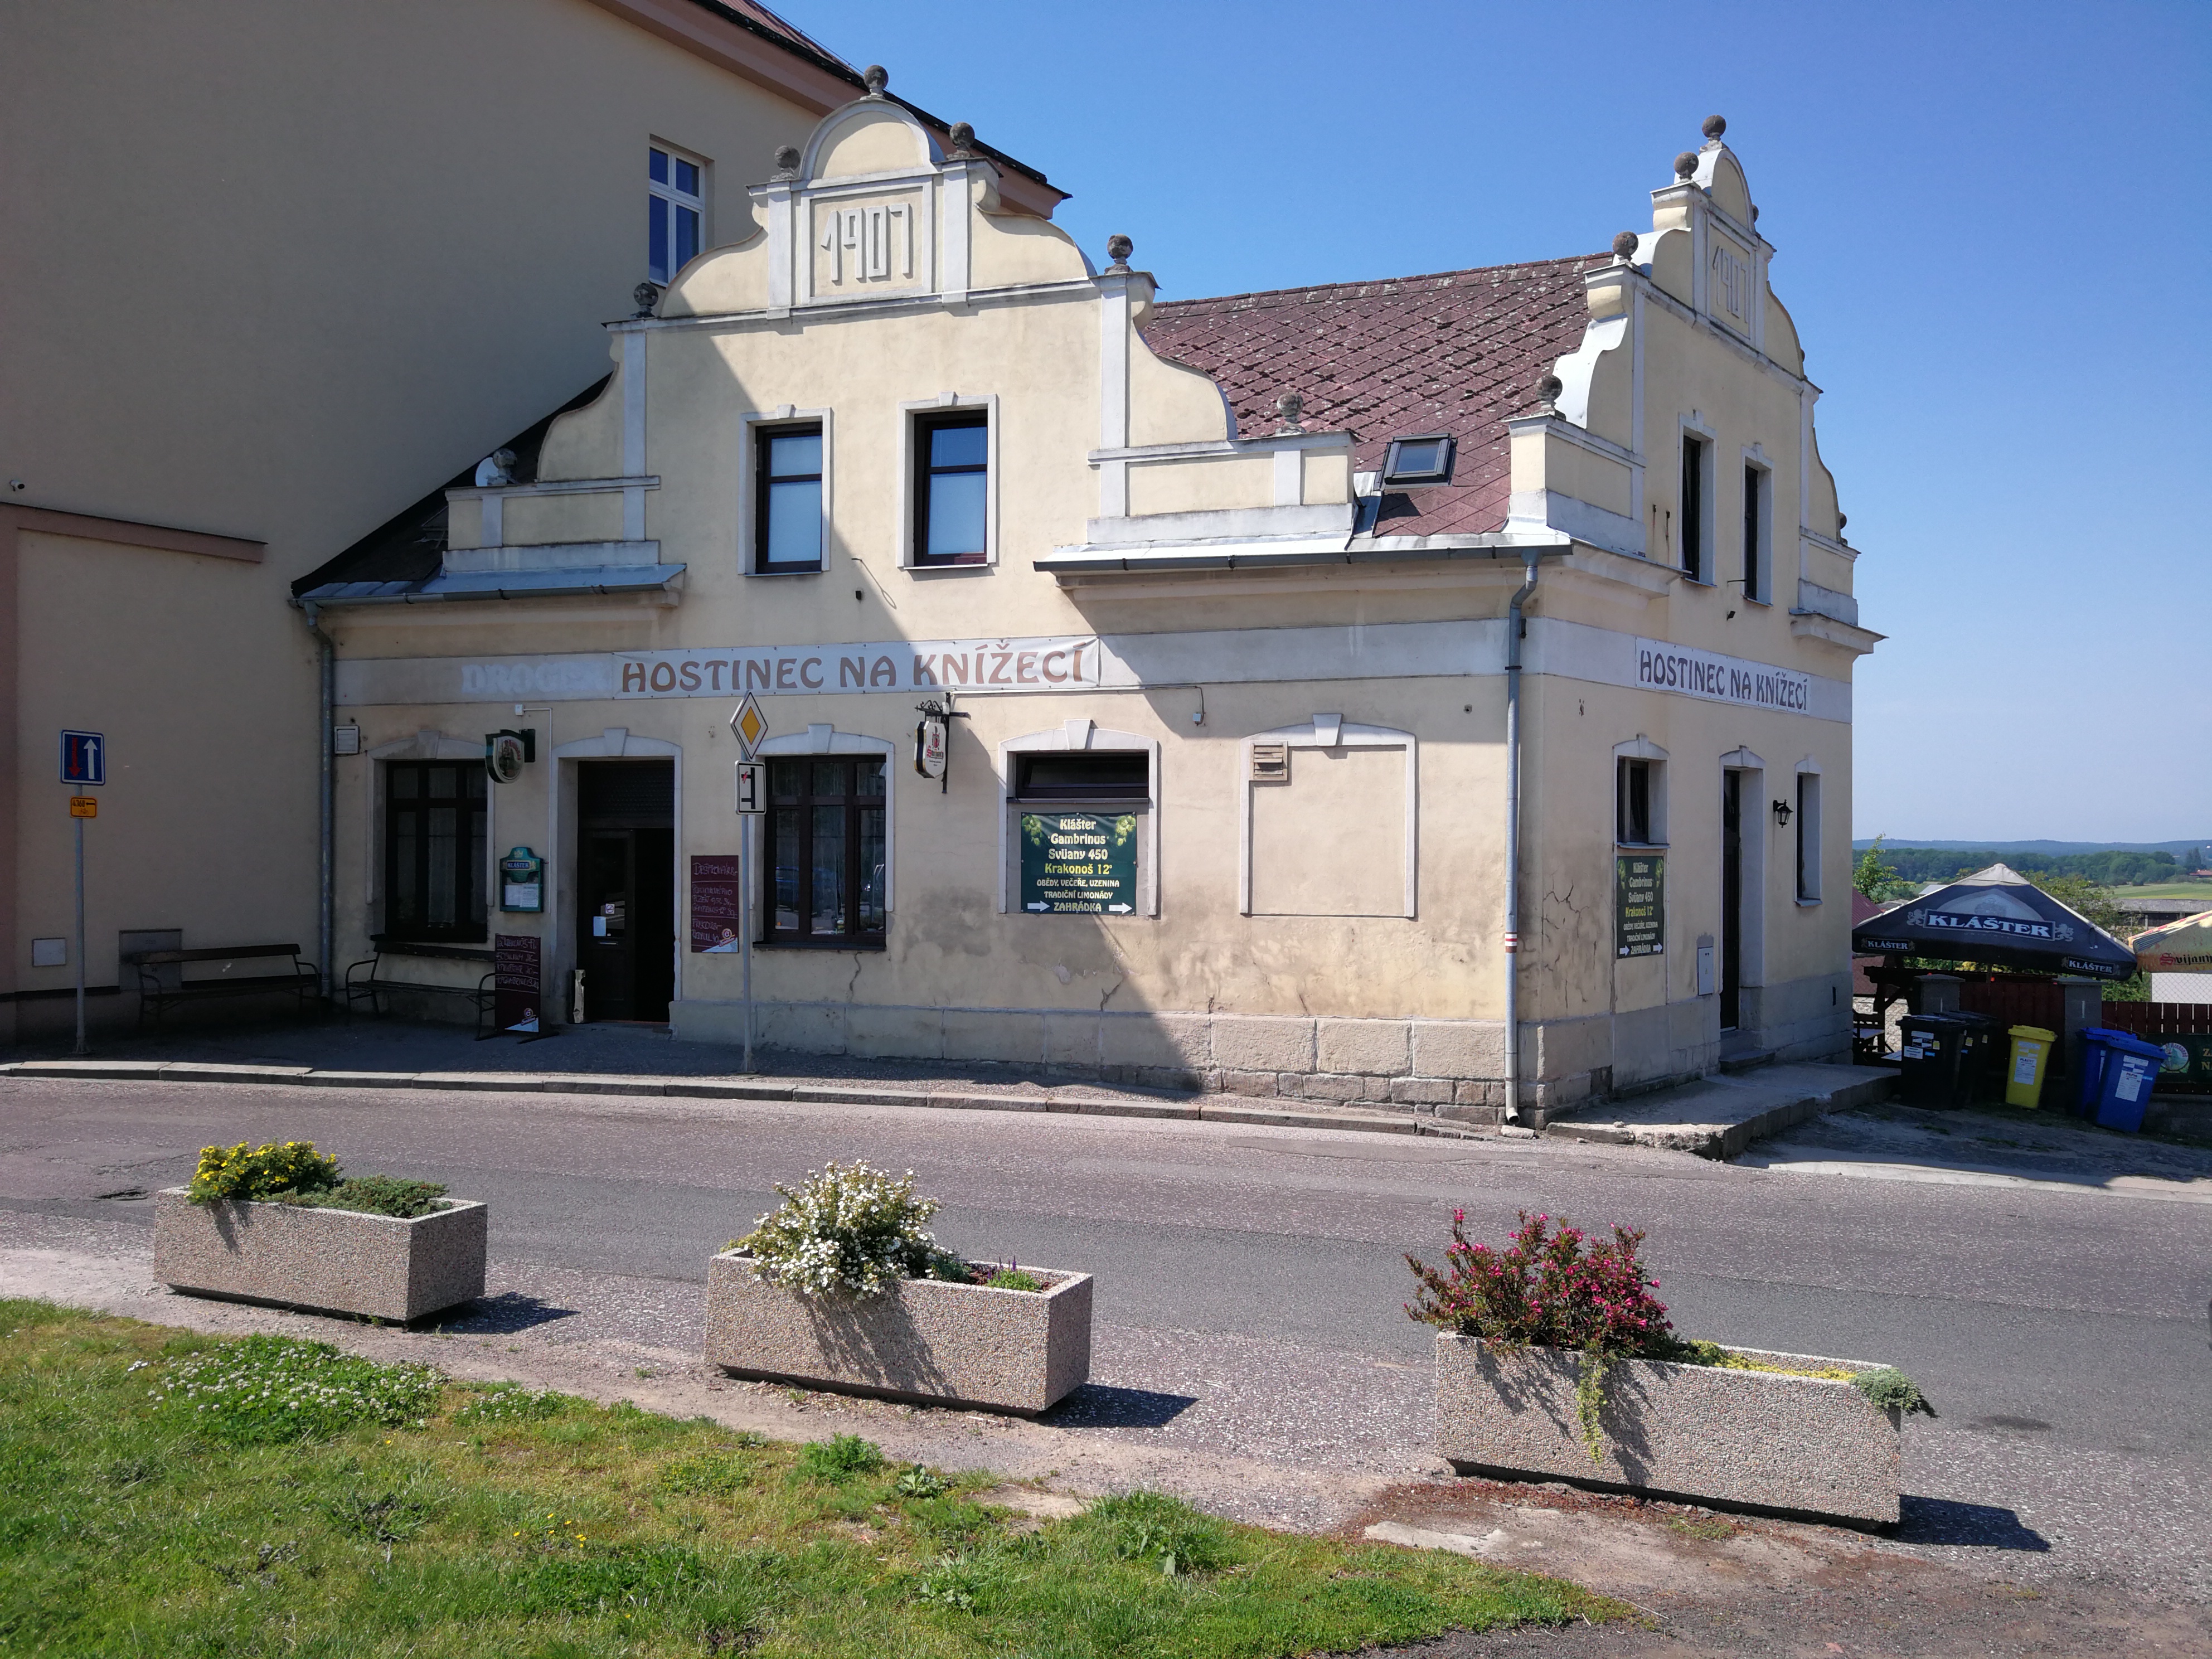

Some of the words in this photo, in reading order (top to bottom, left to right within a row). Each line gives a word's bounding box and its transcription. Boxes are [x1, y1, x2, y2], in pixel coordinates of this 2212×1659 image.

[821, 203, 911, 282] 1907
[623, 657, 824, 692] HOSTINEC
[840, 655, 896, 687] NA
[913, 641, 1086, 686] KNÍŽECÍ
[1639, 650, 1725, 695] HOSTINEC
[1730, 668, 1752, 700] NA
[1756, 672, 1808, 710] KNÍŽECÍ
[1060, 818, 1097, 830] Klášter
[1050, 833, 1106, 845] Gambrinus
[1048, 848, 1085, 860] Svijany
[1088, 849, 1108, 860] 450
[1045, 863, 1093, 874] Krakonoš
[1044, 889, 1076, 899] TRADIČNÍ
[1077, 890, 1113, 899] LIMONÁDY
[1054, 900, 1102, 911] ZAHRÁDKA
[1927, 913, 2051, 938] KLÁŠTER
[1867, 940, 1908, 949] KLÁŠTER
[2069, 960, 2112, 973] KLÁŠTER
